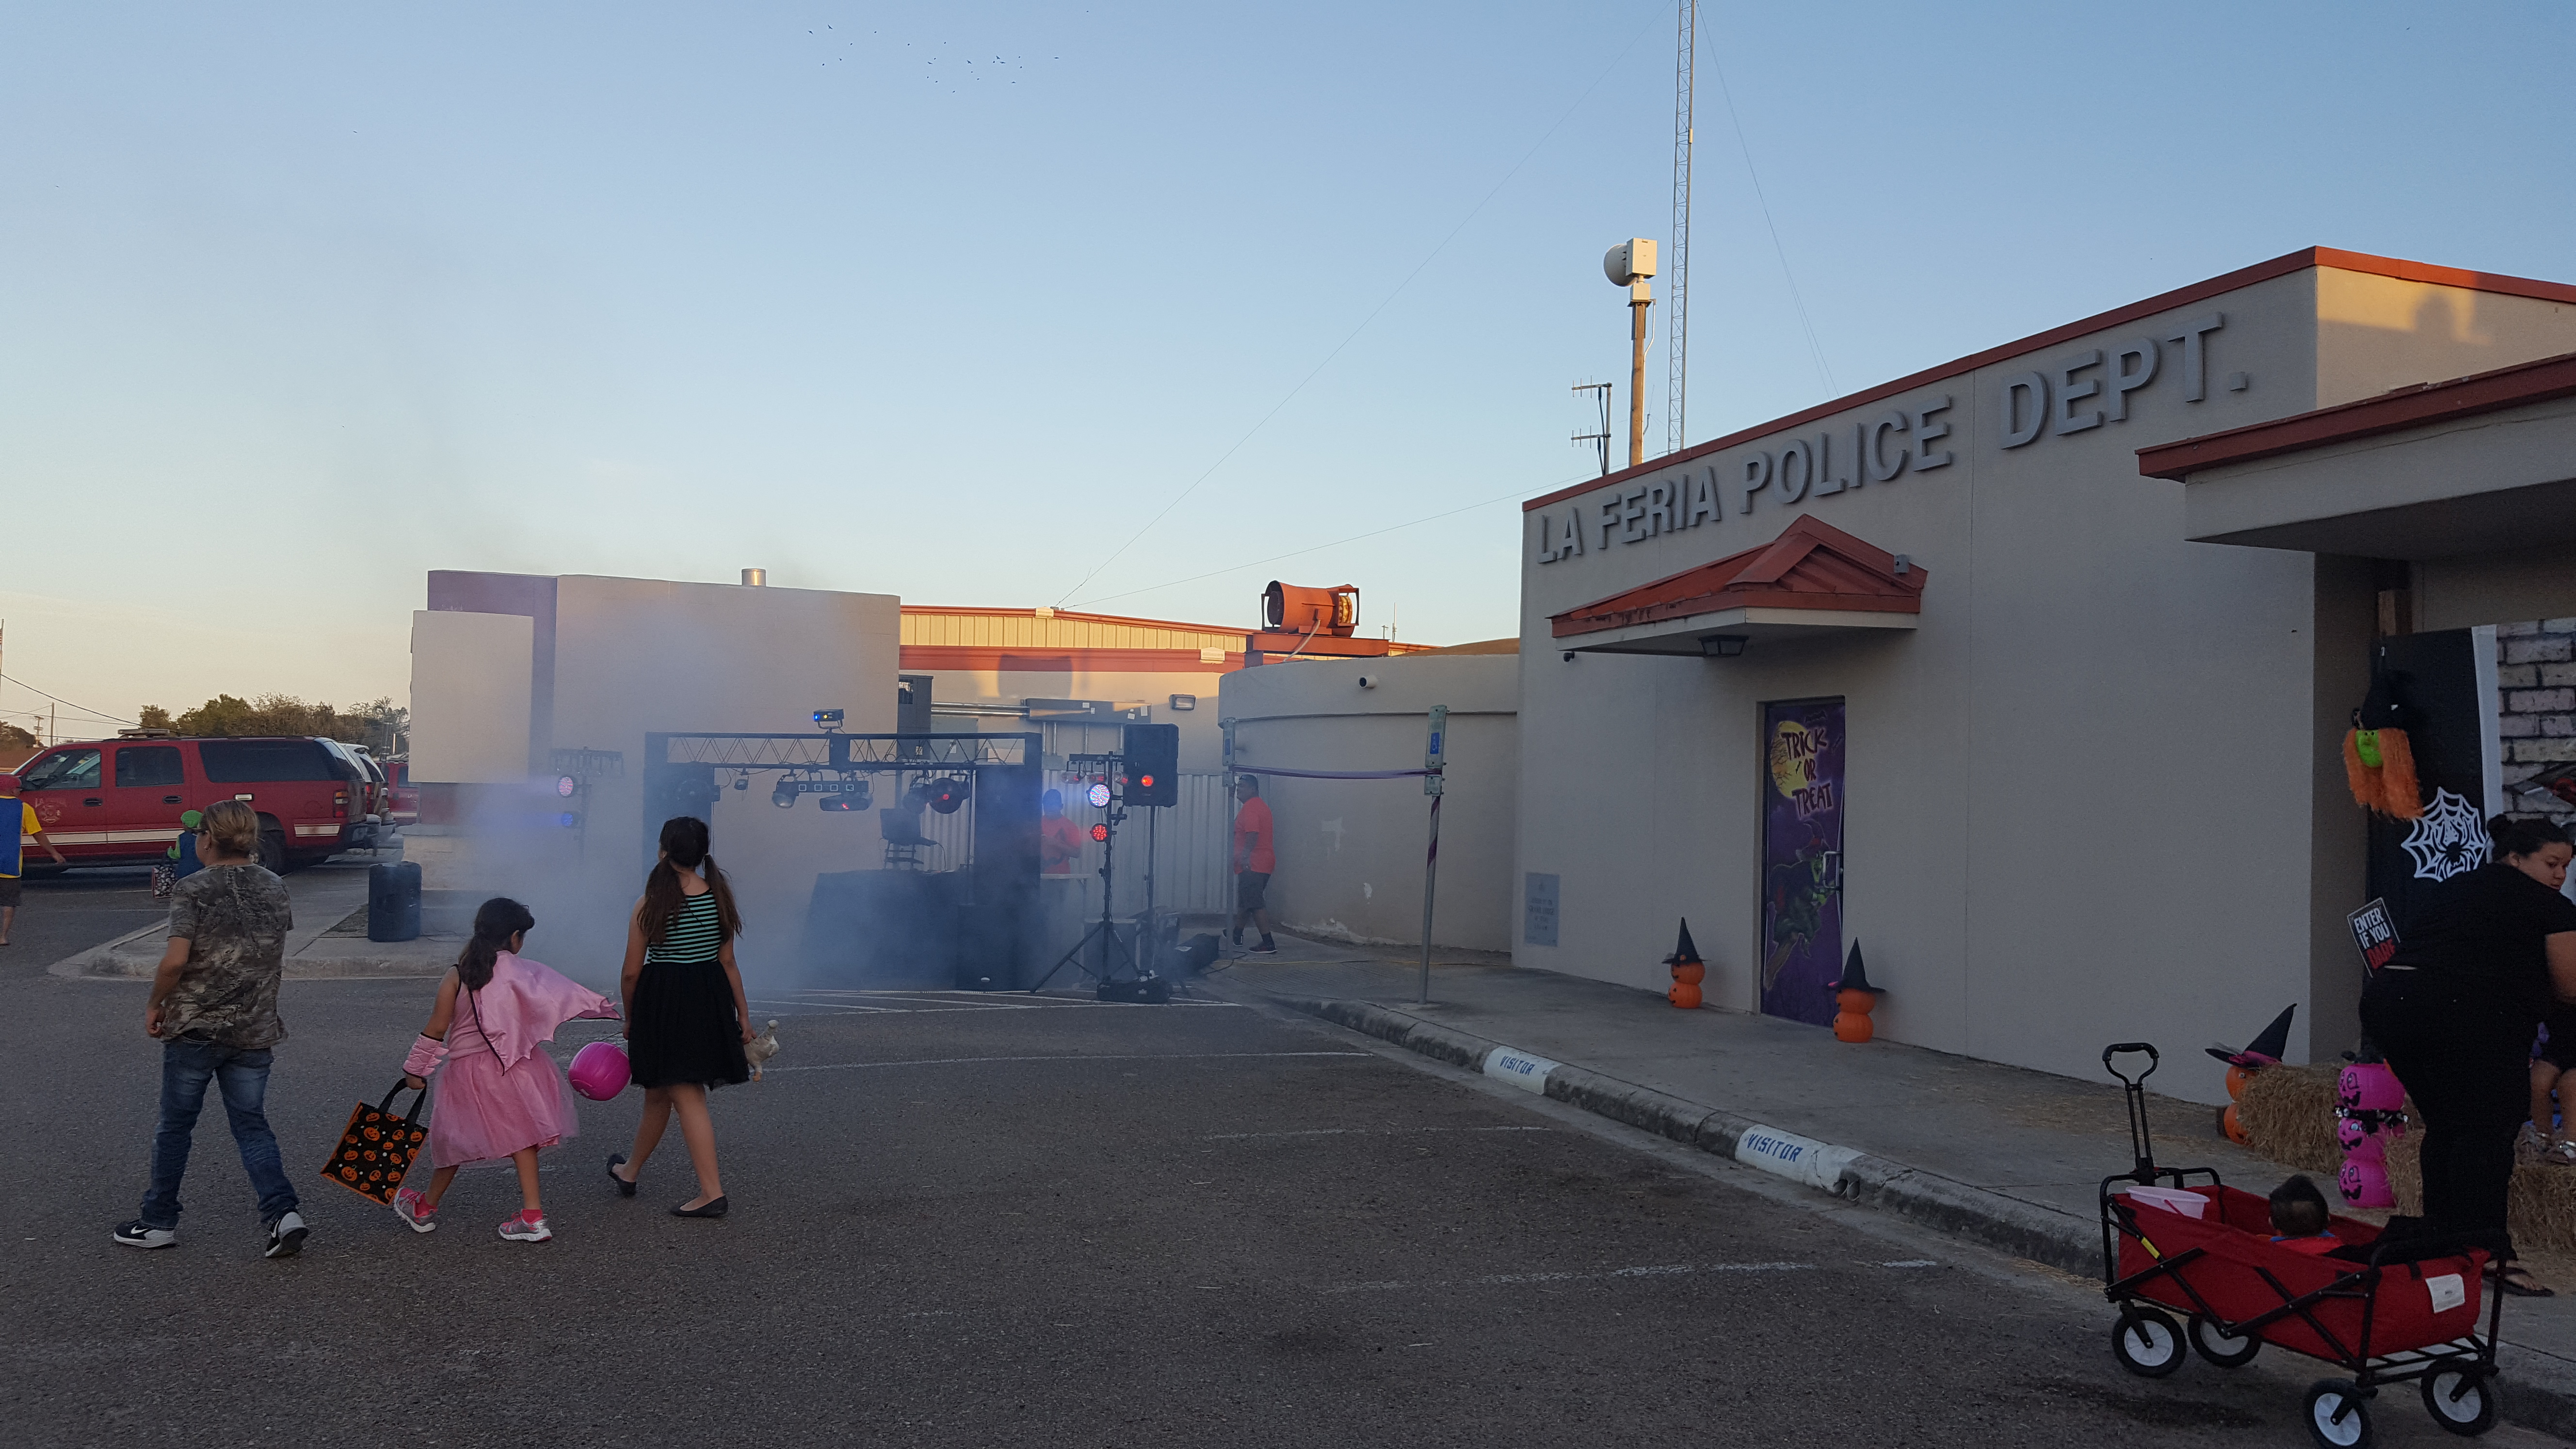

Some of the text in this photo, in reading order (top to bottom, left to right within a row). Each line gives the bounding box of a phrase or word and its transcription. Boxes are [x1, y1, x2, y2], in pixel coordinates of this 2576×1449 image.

[1538, 311, 2248, 564] LA FERIA POLICE DEPT.
[1803, 758, 1817, 782] OR
[1791, 782, 1833, 818] TREAT
[2353, 907, 2384, 934] ENTER
[2359, 922, 2390, 950] IF YOU
[1499, 1055, 1536, 1076] VISITOR
[1747, 1133, 1803, 1162] VISITOR
